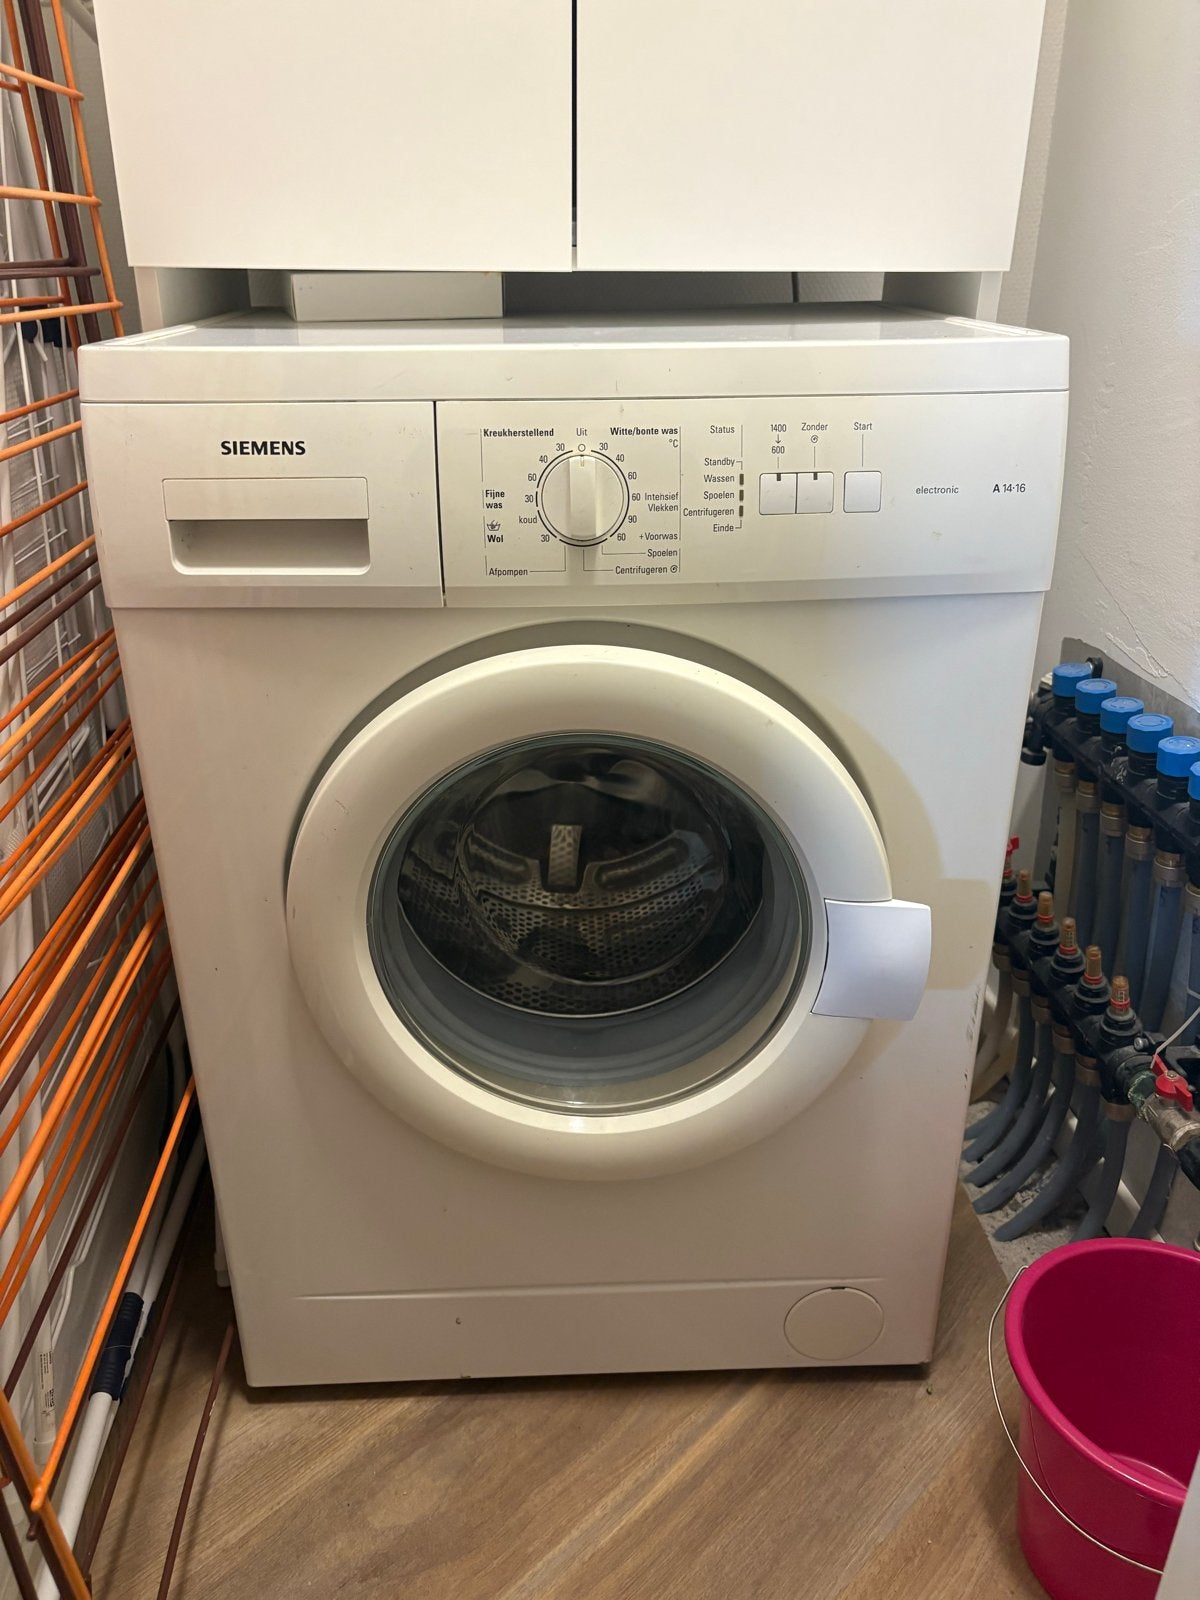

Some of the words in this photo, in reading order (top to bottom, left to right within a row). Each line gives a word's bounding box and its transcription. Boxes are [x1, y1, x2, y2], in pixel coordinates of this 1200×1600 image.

[710, 426, 735, 434] Status
[771, 424, 787, 432] 1400
[801, 423, 828, 431] Zonder
[853, 422, 873, 431] Start
[483, 428, 554, 437] Kreukherstellend
[576, 428, 587, 437] Uit
[610, 427, 659, 436] Witte/bonte
[221, 441, 306, 456] SIEMENS
[556, 443, 565, 452] 30
[599, 443, 609, 451] 30
[771, 446, 785, 455] 600
[539, 455, 548, 464] 40
[616, 454, 625, 462] 40
[704, 458, 735, 467] Standby
[528, 473, 537, 482] 60
[628, 472, 637, 480] 60
[704, 475, 735, 483] Wassen
[916, 486, 959, 494] electronic
[992, 484, 1000, 493] A
[485, 490, 505, 499] Fijne
[525, 495, 534, 503] 30
[632, 493, 641, 501] 60
[645, 493, 679, 501] Intensief
[703, 491, 735, 501] Spoelen
[648, 504, 679, 512] Vlekken
[683, 508, 735, 518] Centrifugeren
[519, 516, 538, 524] koud
[628, 515, 637, 524] 90
[713, 524, 734, 533] Einde
[487, 535, 504, 543] Wol
[541, 534, 550, 542] 30
[617, 533, 626, 541] 60
[648, 549, 678, 559] Spoelen
[489, 567, 528, 577] Afpompen
[615, 565, 668, 575] Centrifugeren
